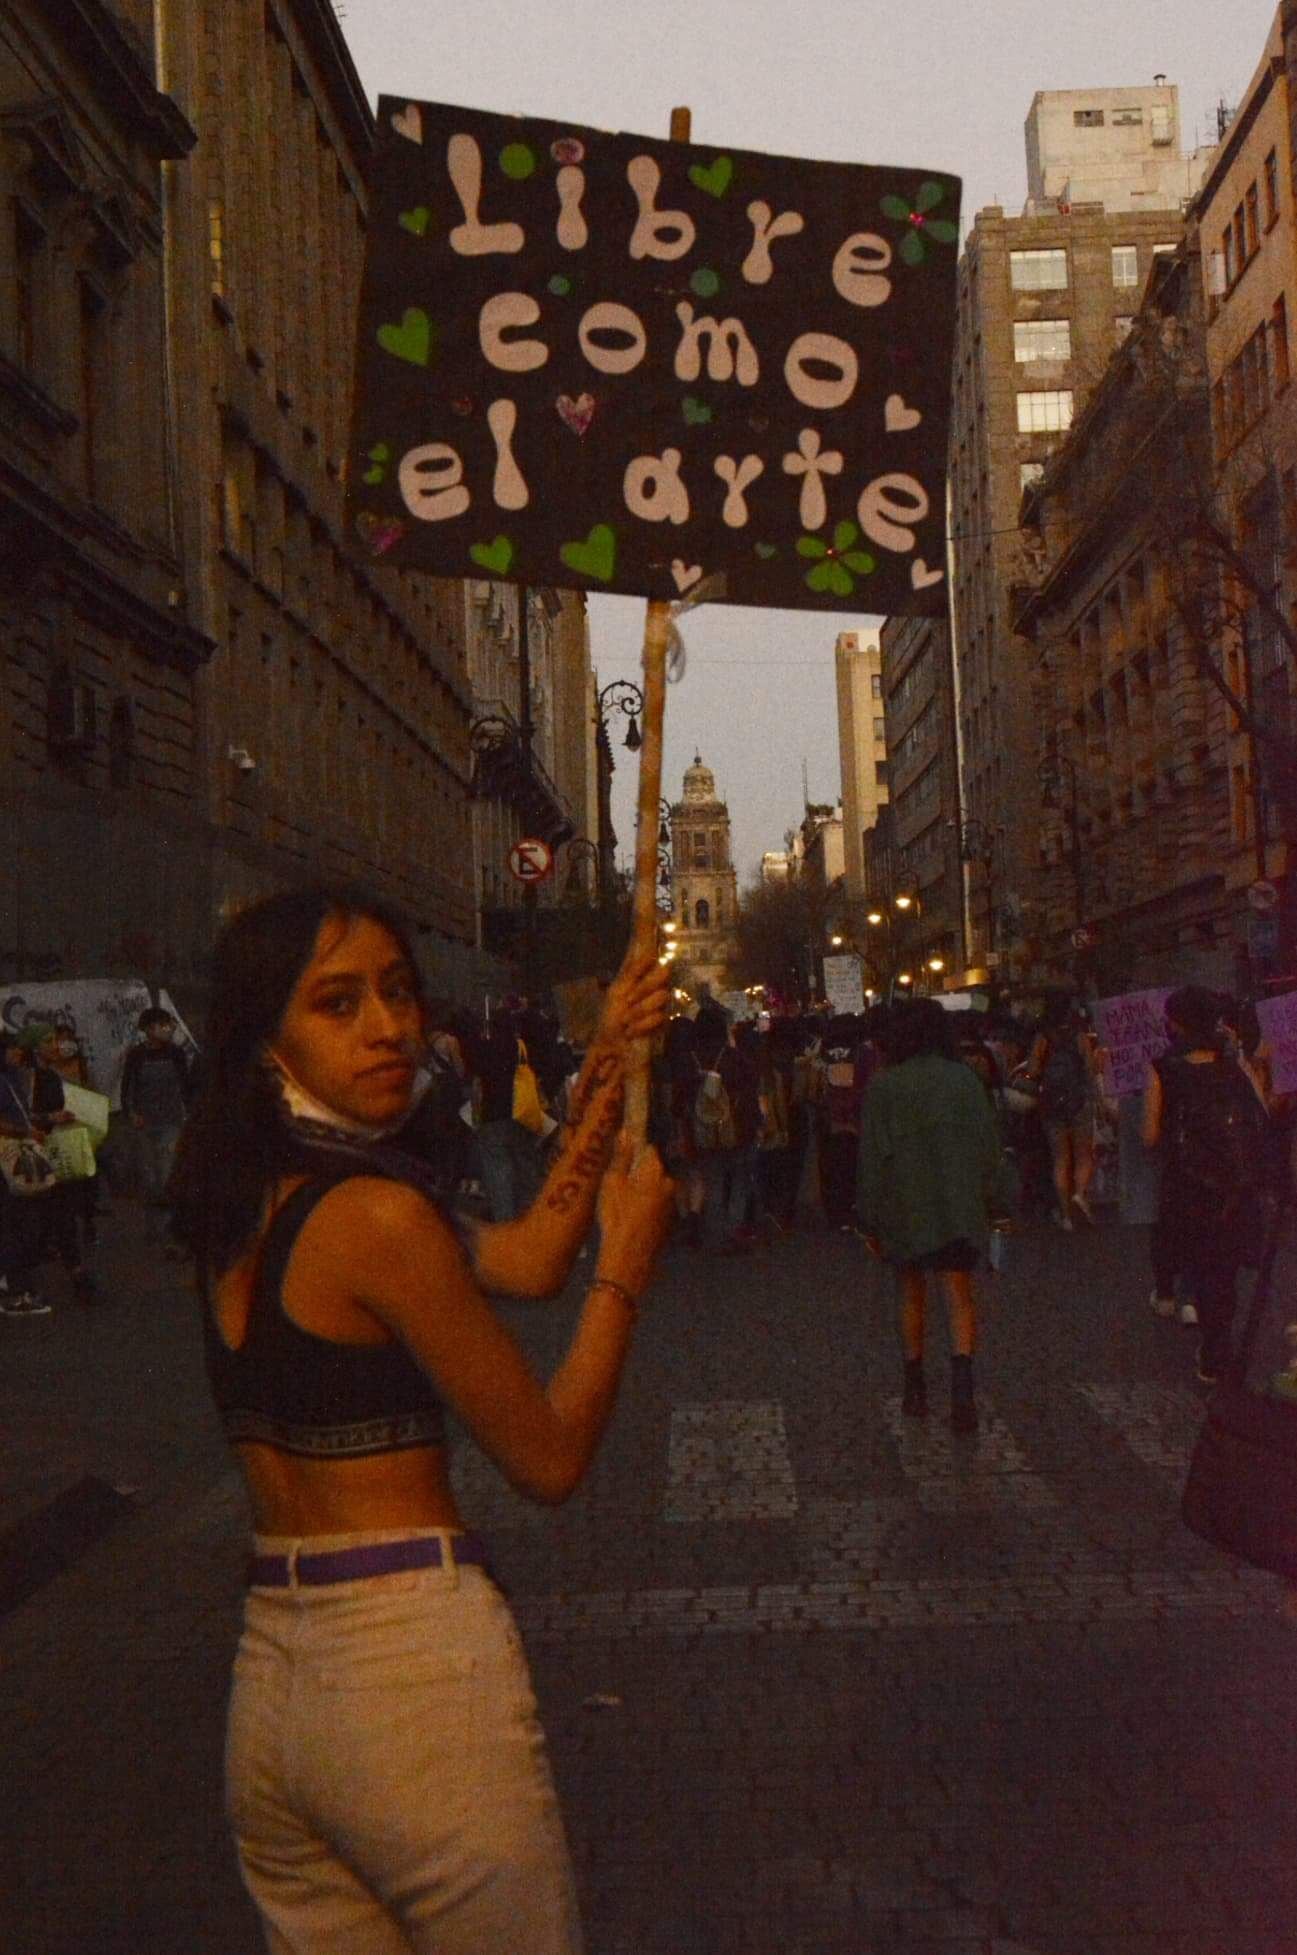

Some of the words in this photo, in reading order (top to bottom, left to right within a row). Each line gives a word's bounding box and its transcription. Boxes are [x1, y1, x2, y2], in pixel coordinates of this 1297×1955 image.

[447, 133, 893, 308] Libre
[478, 291, 859, 410] como
[398, 398, 530, 522] el
[622, 426, 930, 553] arte
